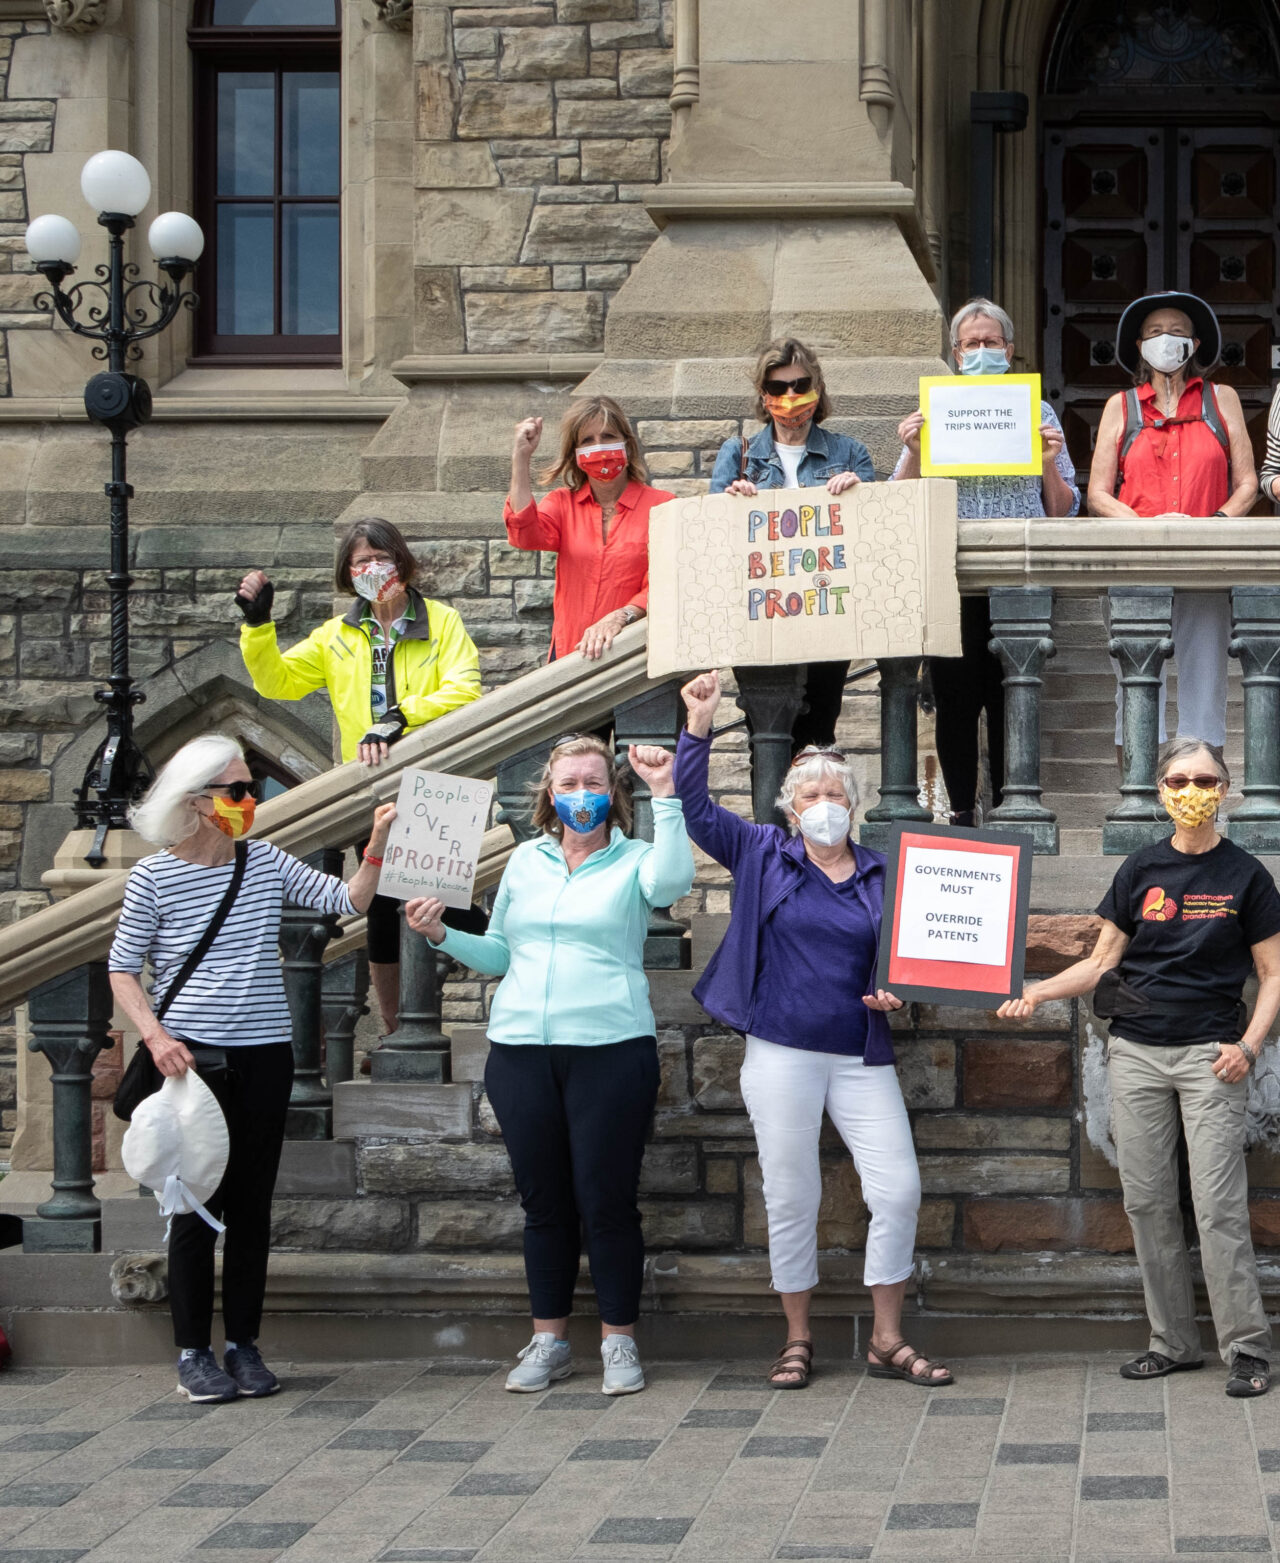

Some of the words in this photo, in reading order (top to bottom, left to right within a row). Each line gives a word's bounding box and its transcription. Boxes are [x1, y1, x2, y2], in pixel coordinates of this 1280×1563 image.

[948, 409, 992, 418] SUPPORT
[995, 408, 1013, 417] THE
[974, 422, 1016, 430] WAIVER!!
[748, 503, 843, 542] PEOPLE
[748, 544, 846, 579] BEFORE
[413, 776, 470, 804] People
[915, 865, 1002, 882] GOVERNMENTS
[940, 883, 974, 895] MUST
[925, 912, 983, 926] OVERRIDE
[928, 929, 978, 942] PATENTS
